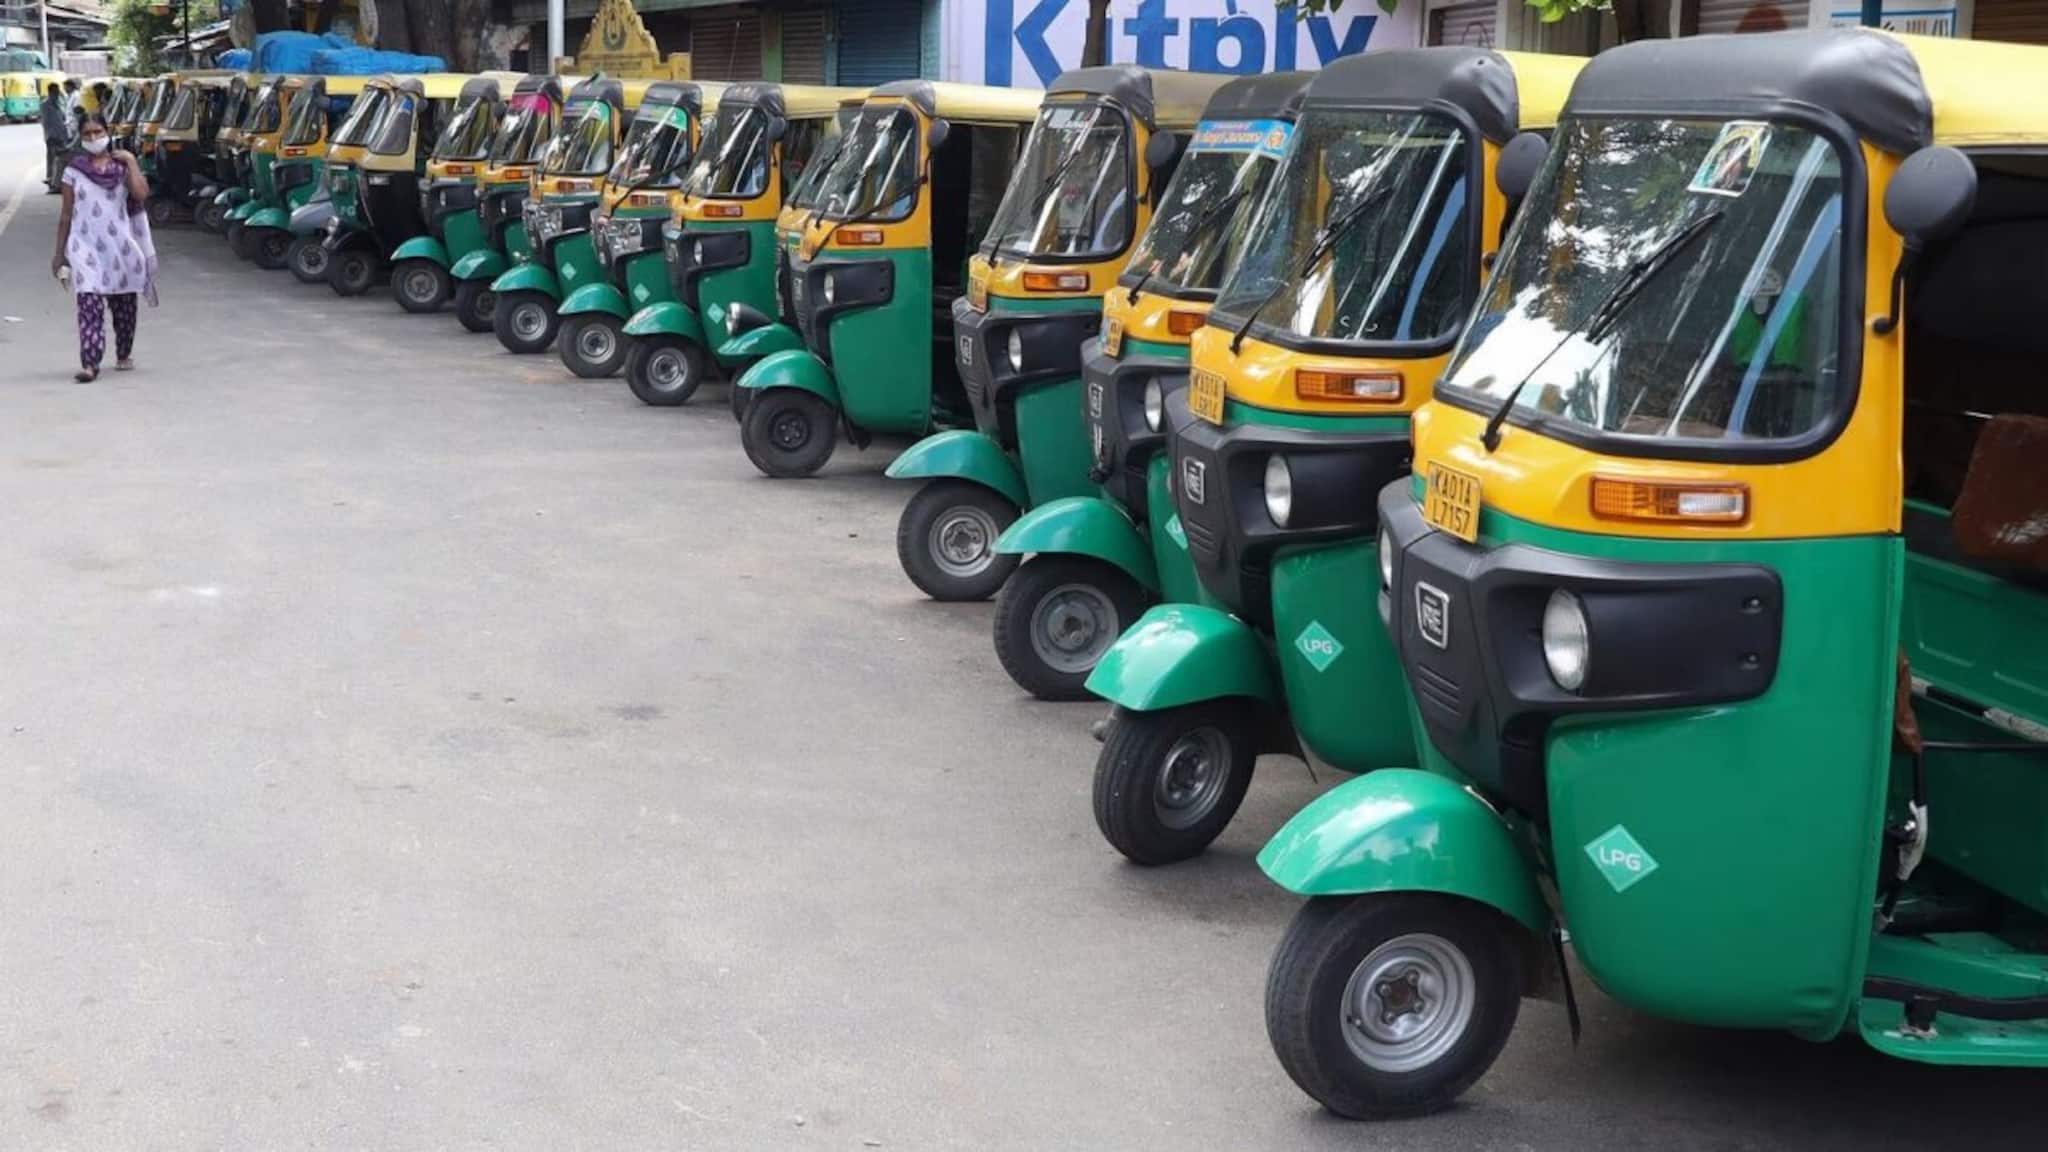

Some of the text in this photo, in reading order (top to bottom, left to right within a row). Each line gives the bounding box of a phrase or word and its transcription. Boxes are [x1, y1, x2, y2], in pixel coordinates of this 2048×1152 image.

[1435, 468, 1471, 506] KA01A
[1432, 499, 1470, 536] L7157
[1303, 638, 1333, 655] LPG
[1600, 847, 1641, 872] LPG
